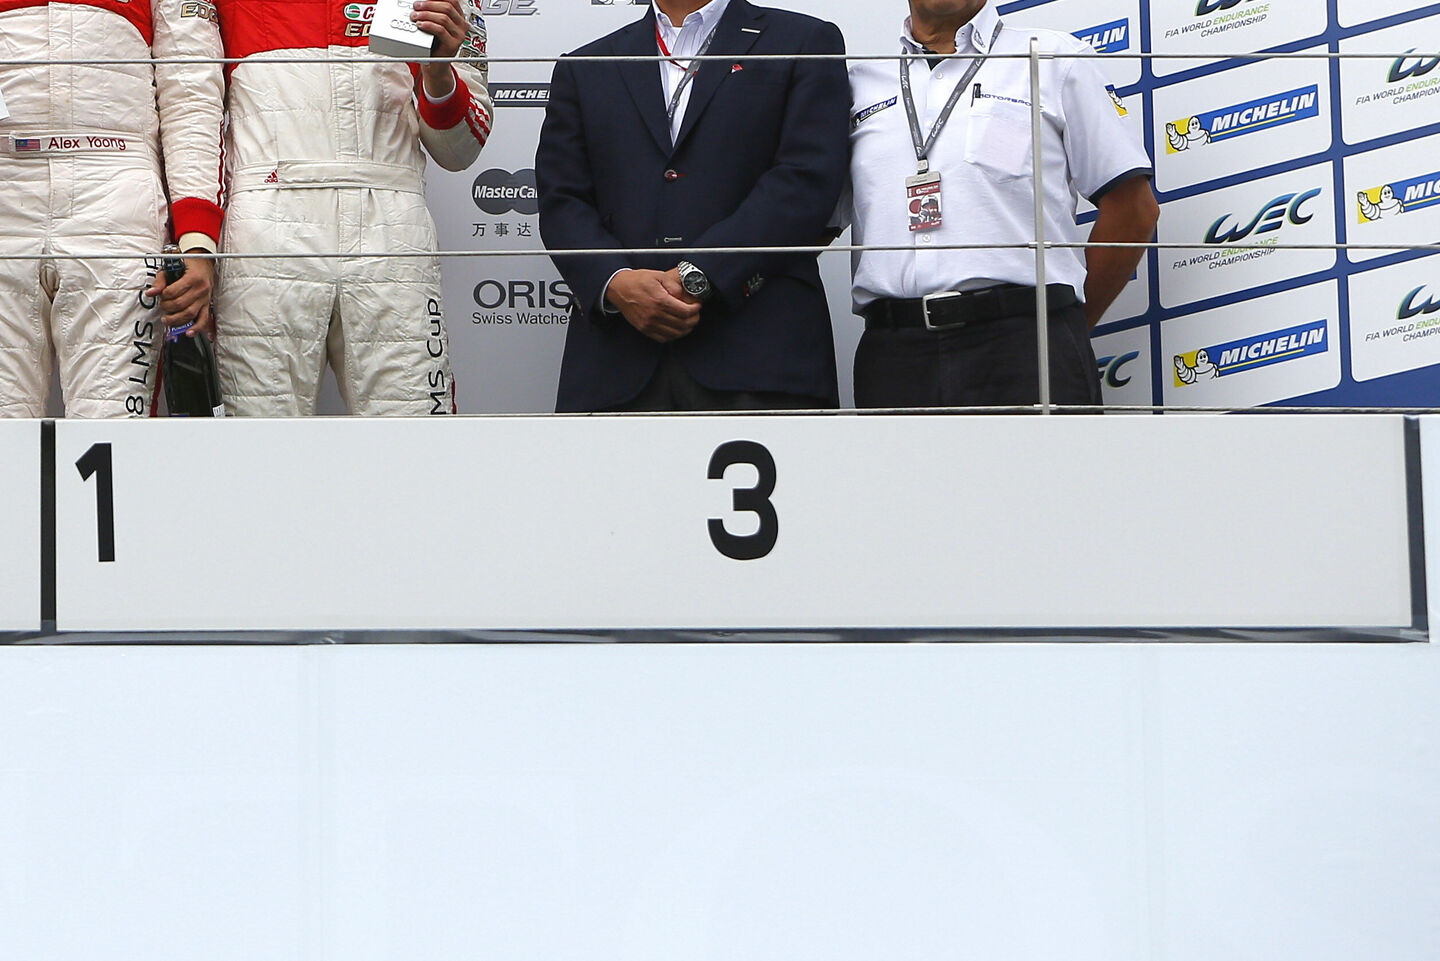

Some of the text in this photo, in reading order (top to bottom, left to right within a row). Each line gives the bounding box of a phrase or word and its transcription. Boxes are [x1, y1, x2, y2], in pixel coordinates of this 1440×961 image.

[1165, 3, 1270, 38] FIA WORLD ENDURANCE
[1200, 13, 1267, 38] CHAMPIONSHIP
[860, 96, 897, 119] MICHELIN
[1211, 92, 1316, 131] MICHELIN
[48, 135, 126, 151] Alex Yoong
[474, 184, 538, 200] MasterCa
[1208, 247, 1276, 270] CHAMPIONSHIP
[473, 280, 573, 308] ORIS
[427, 298, 443, 358] Cup
[472, 312, 512, 325] Swiss
[129, 320, 153, 384] LMS
[1220, 327, 1325, 366] MICHELIN
[75, 442, 115, 562] 1
[707, 440, 779, 560] 3
